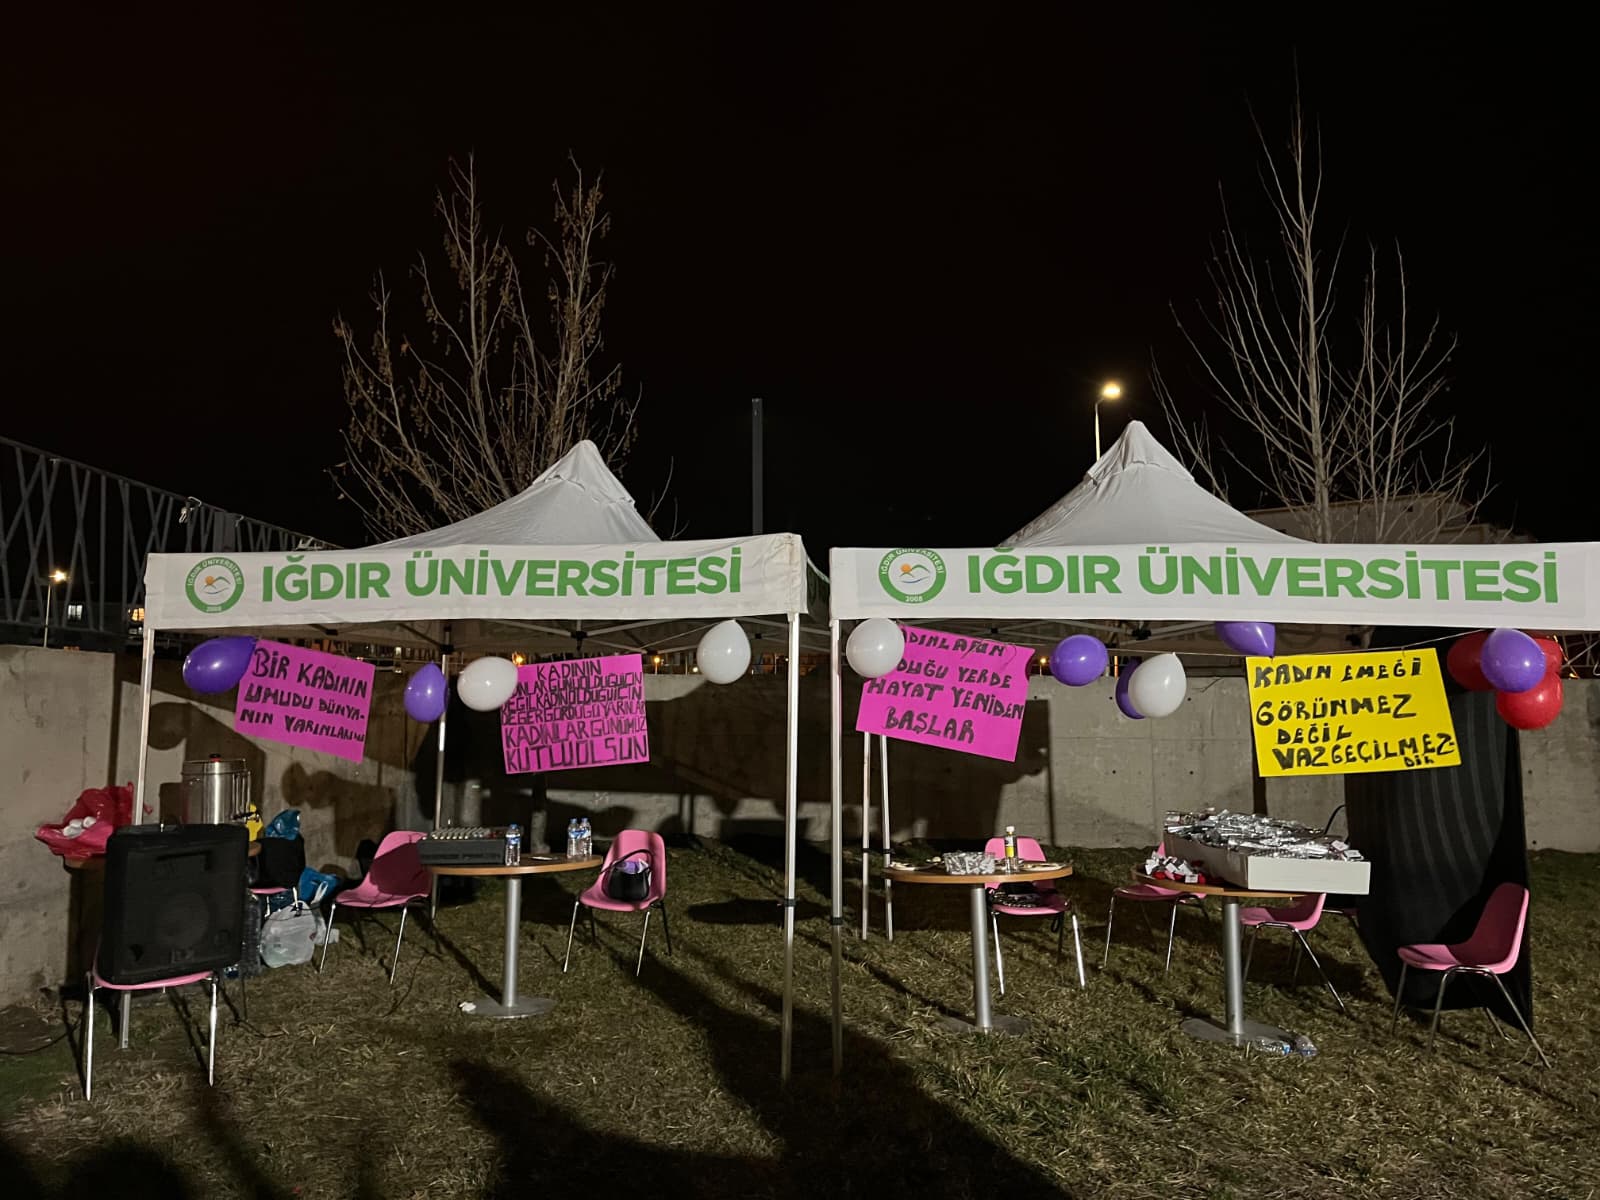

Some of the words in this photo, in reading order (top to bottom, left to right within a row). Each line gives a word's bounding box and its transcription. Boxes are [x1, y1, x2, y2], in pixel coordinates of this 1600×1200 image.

[262, 555, 391, 602] IĞDIR
[405, 547, 742, 597] ÜNİVERSİTESİ
[968, 547, 1122, 594] IĞDIR
[1138, 546, 1558, 604] ÜNİVERSİTESİ
[252, 648, 290, 680] BİR
[297, 663, 368, 698] KADININ
[536, 660, 601, 681] KADININ
[958, 666, 1012, 689] YERDE
[1254, 664, 1332, 688] KADIN
[1341, 657, 1421, 682] EMEĞİ
[244, 683, 314, 709] UMUDU
[866, 678, 945, 701] HAYAT
[951, 686, 1025, 720] YENİDEN
[1256, 694, 1417, 726] GÖRÜNMEZ
[240, 709, 274, 725] NIN
[885, 705, 975, 744] BAŞLAR
[1277, 722, 1352, 744] DEĞİL
